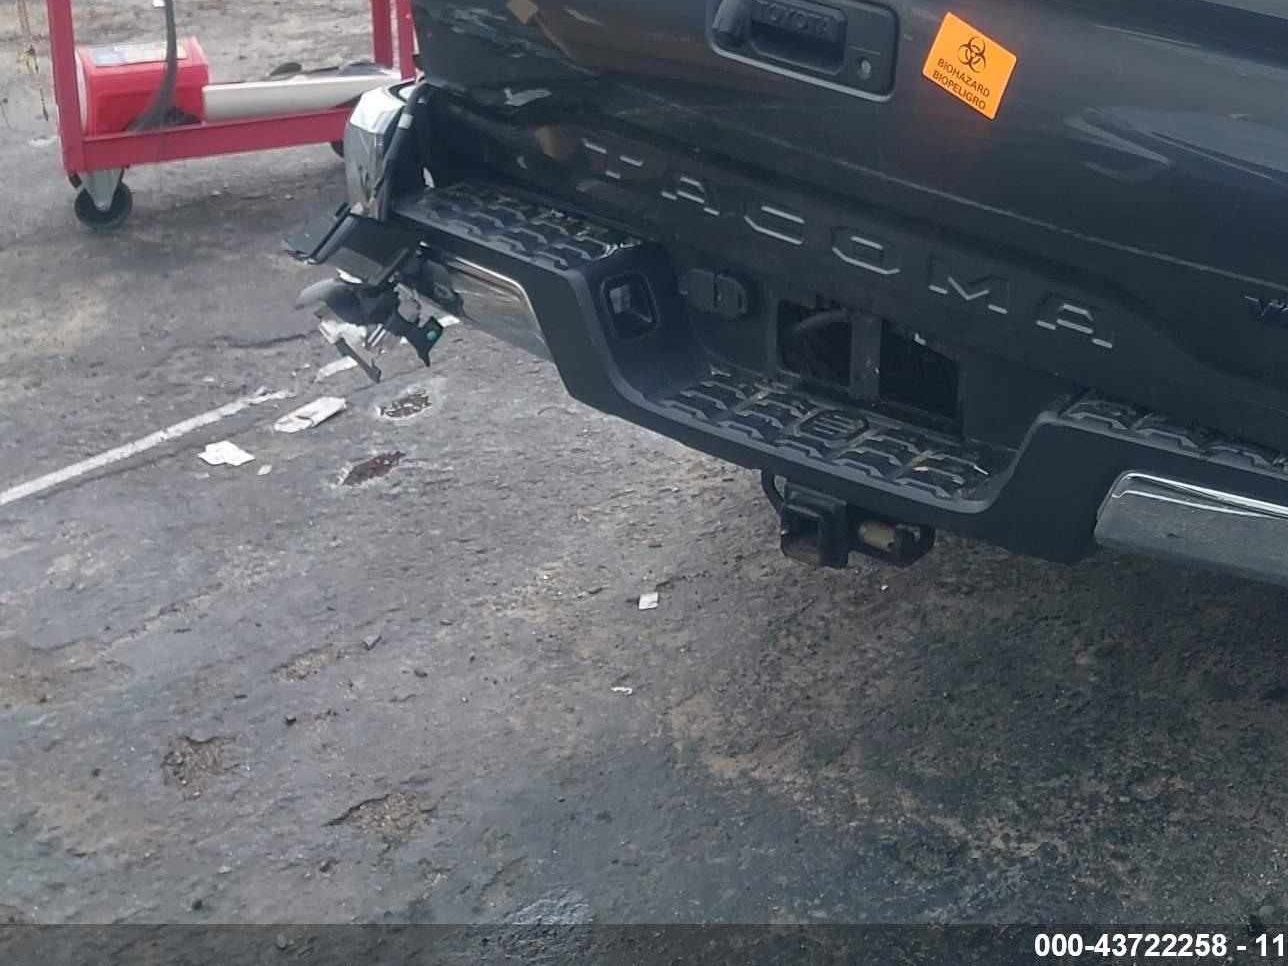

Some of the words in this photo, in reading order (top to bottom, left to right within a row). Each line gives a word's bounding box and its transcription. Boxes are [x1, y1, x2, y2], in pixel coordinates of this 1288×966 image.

[756, 0, 834, 36] TOYOTA
[932, 68, 987, 111] BIOPELIGRO
[937, 56, 991, 99] BIOHAZARD
[582, 138, 1115, 350] TACOMA
